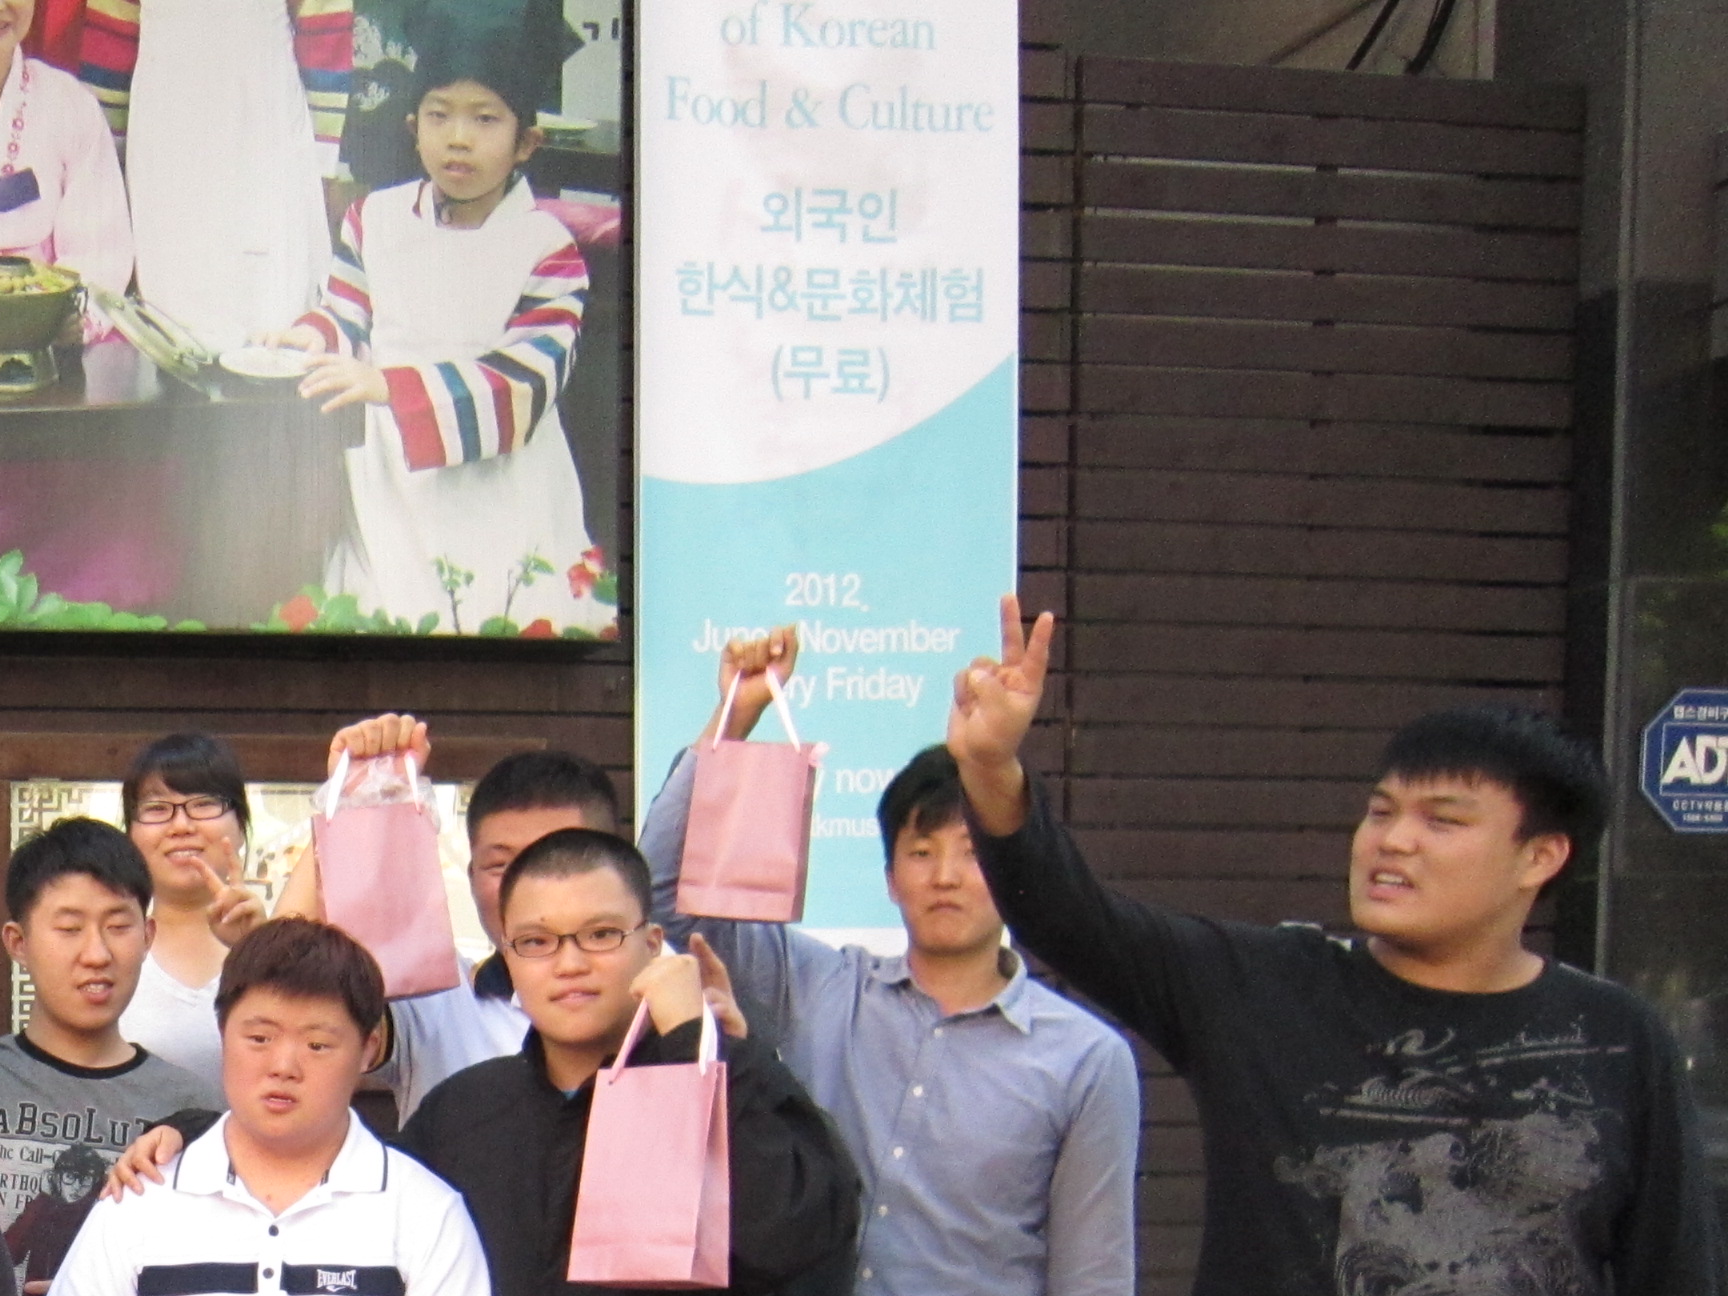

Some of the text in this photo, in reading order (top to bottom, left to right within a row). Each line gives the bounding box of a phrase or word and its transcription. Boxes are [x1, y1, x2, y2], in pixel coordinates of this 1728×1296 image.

[721, 0, 937, 50] of Korean
[665, 75, 995, 133] Food & Culture
[759, 186, 899, 244] 외국인
[674, 259, 986, 324] 한식&문화체험
[770, 343, 891, 404] (무료)
[797, 619, 962, 654] November
[827, 666, 923, 709] Friday
[316, 1268, 358, 1289] EVERLAST
